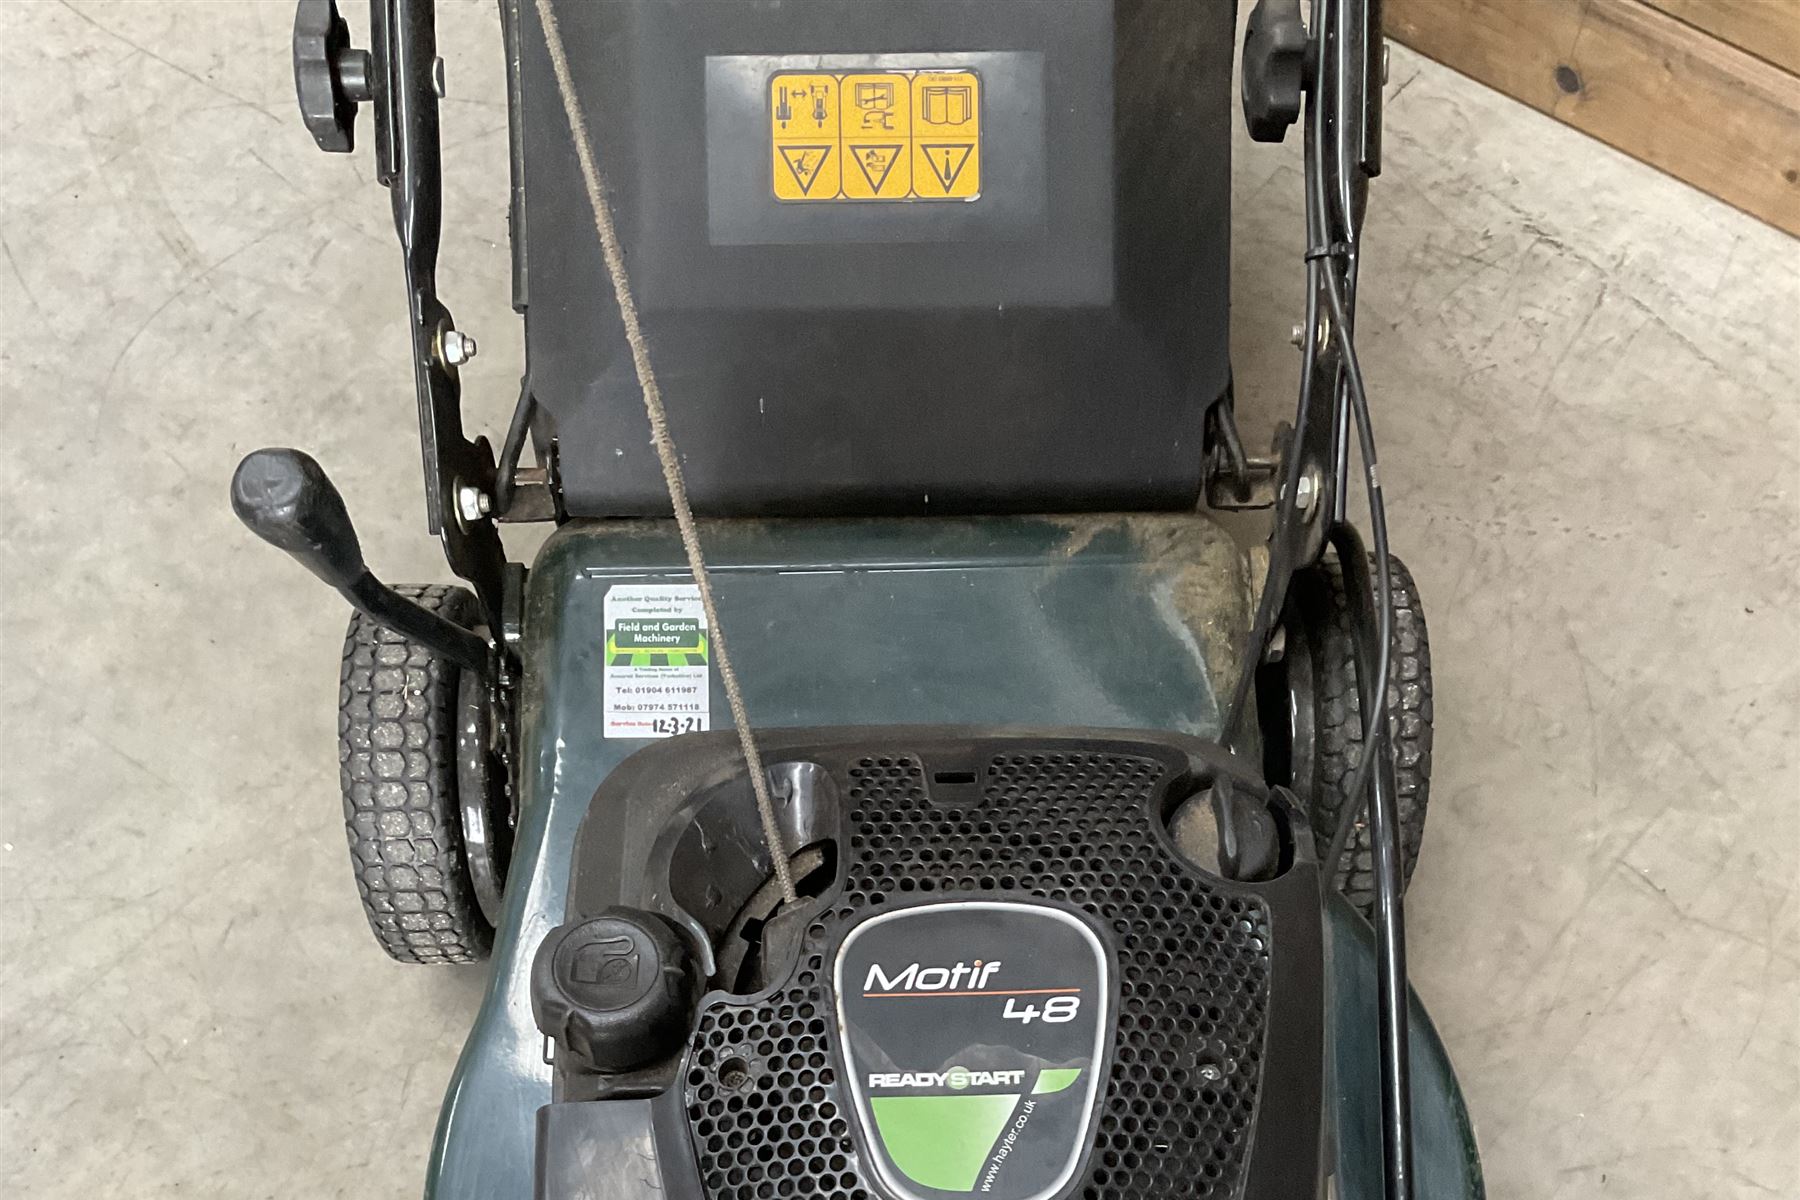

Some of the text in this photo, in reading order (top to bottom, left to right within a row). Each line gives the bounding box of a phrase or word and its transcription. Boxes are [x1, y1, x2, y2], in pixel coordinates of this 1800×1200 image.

[618, 622, 696, 632] Field and Garden
[634, 633, 681, 644] Machinery
[863, 959, 1001, 991] Motif
[1002, 996, 1081, 1024] 48
[869, 1069, 1025, 1088] READYSTART
[981, 1099, 1037, 1193] www.hayter.co.uk
